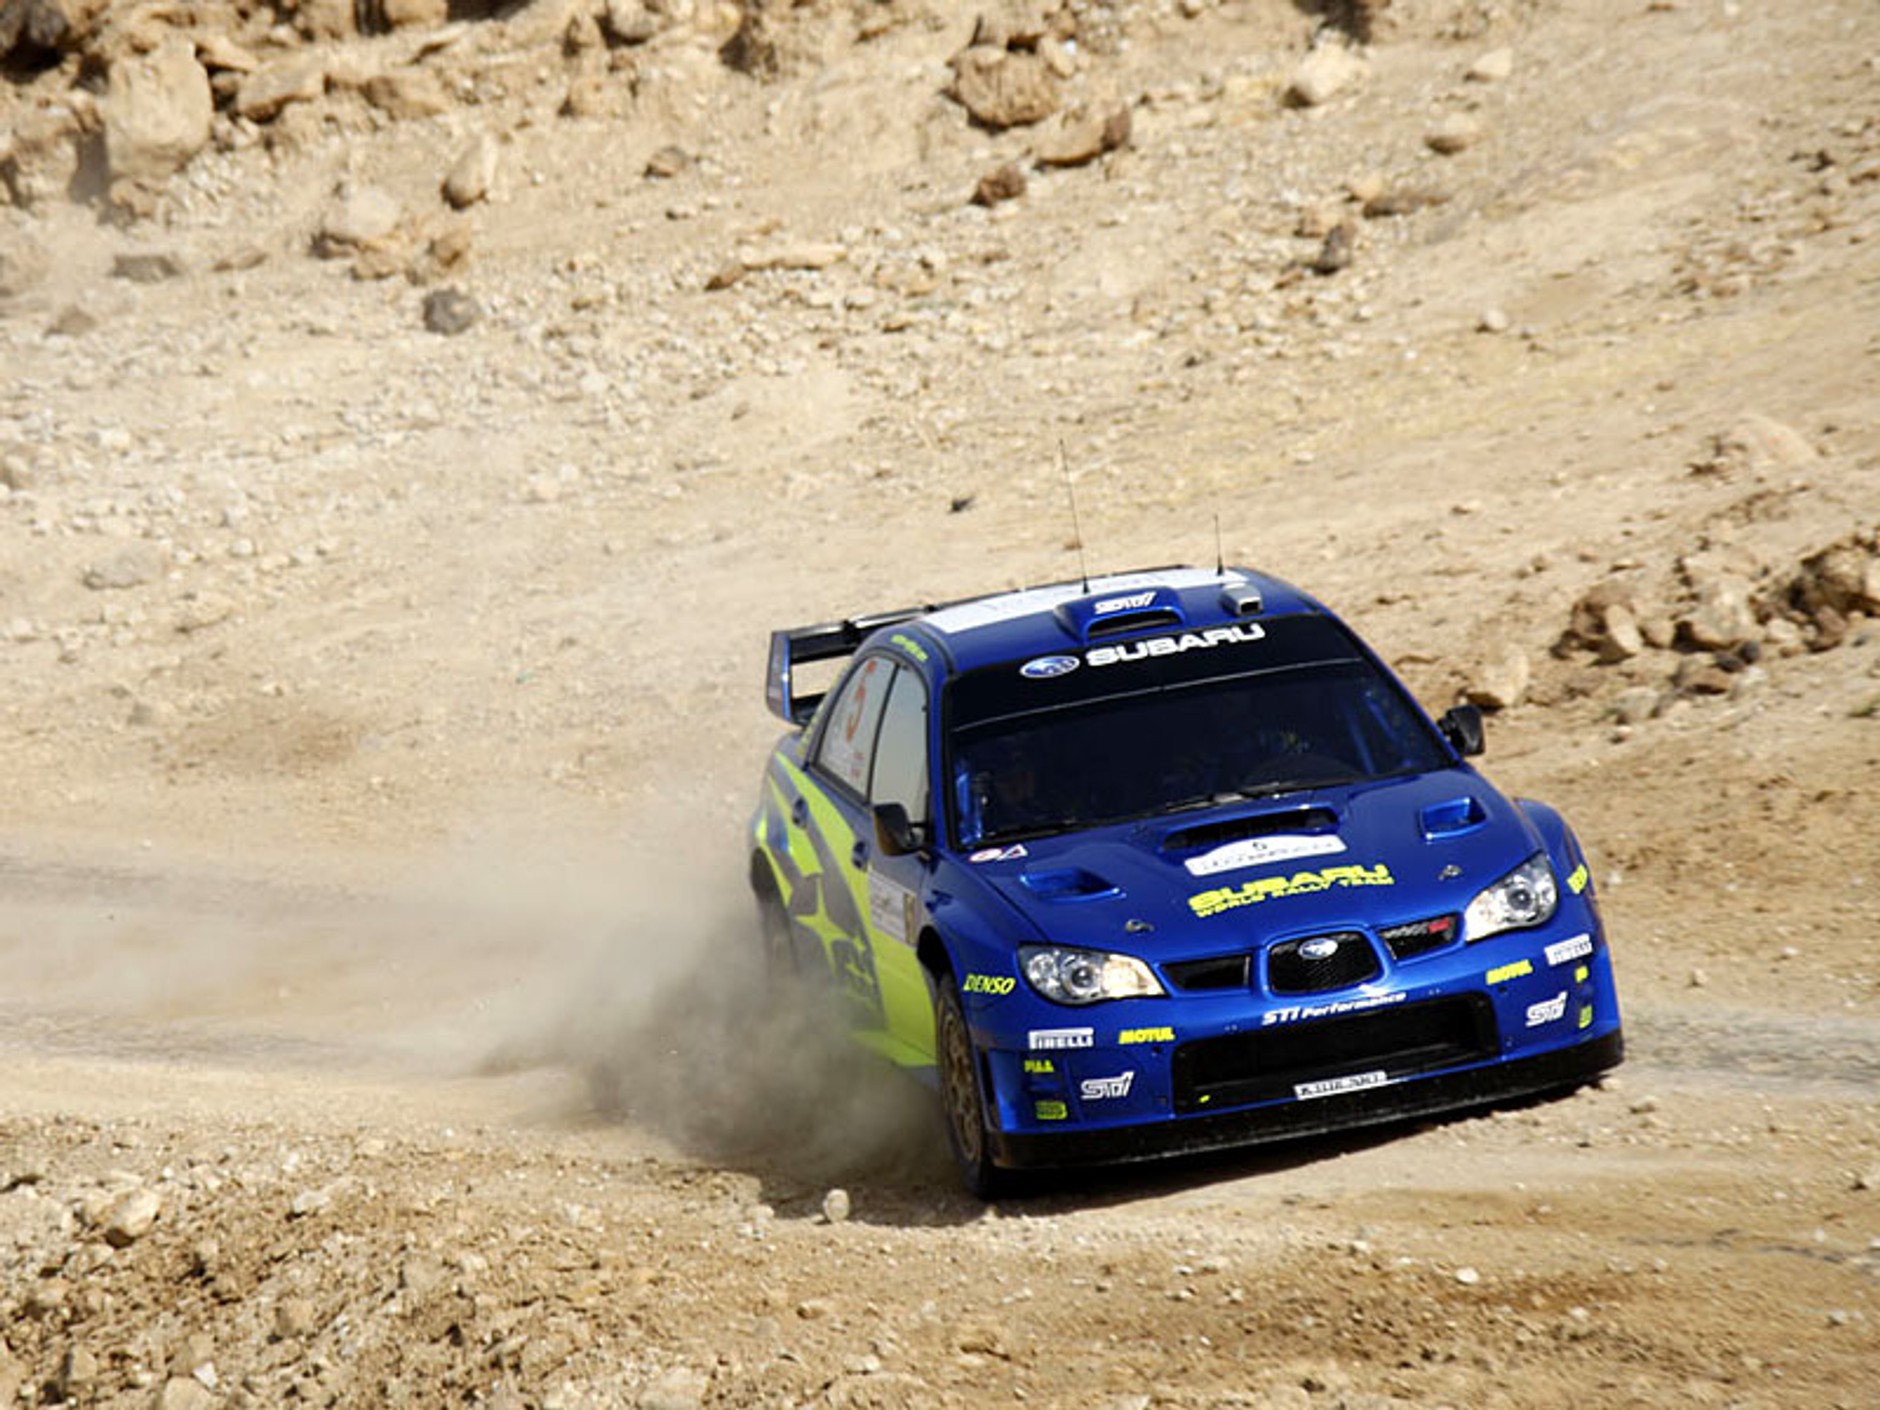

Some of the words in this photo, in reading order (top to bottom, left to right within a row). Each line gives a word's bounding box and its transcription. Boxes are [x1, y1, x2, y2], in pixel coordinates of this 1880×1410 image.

[1085, 623, 1267, 667] SUBARU
[1188, 863, 1389, 913] SUBARU
[963, 974, 1017, 995] DENSO
[1261, 1006, 1301, 1026] STI
[1301, 991, 1407, 1019] Performance
[1028, 1027, 1094, 1050] PIRELLI
[1118, 1026, 1176, 1045] MOTUL
